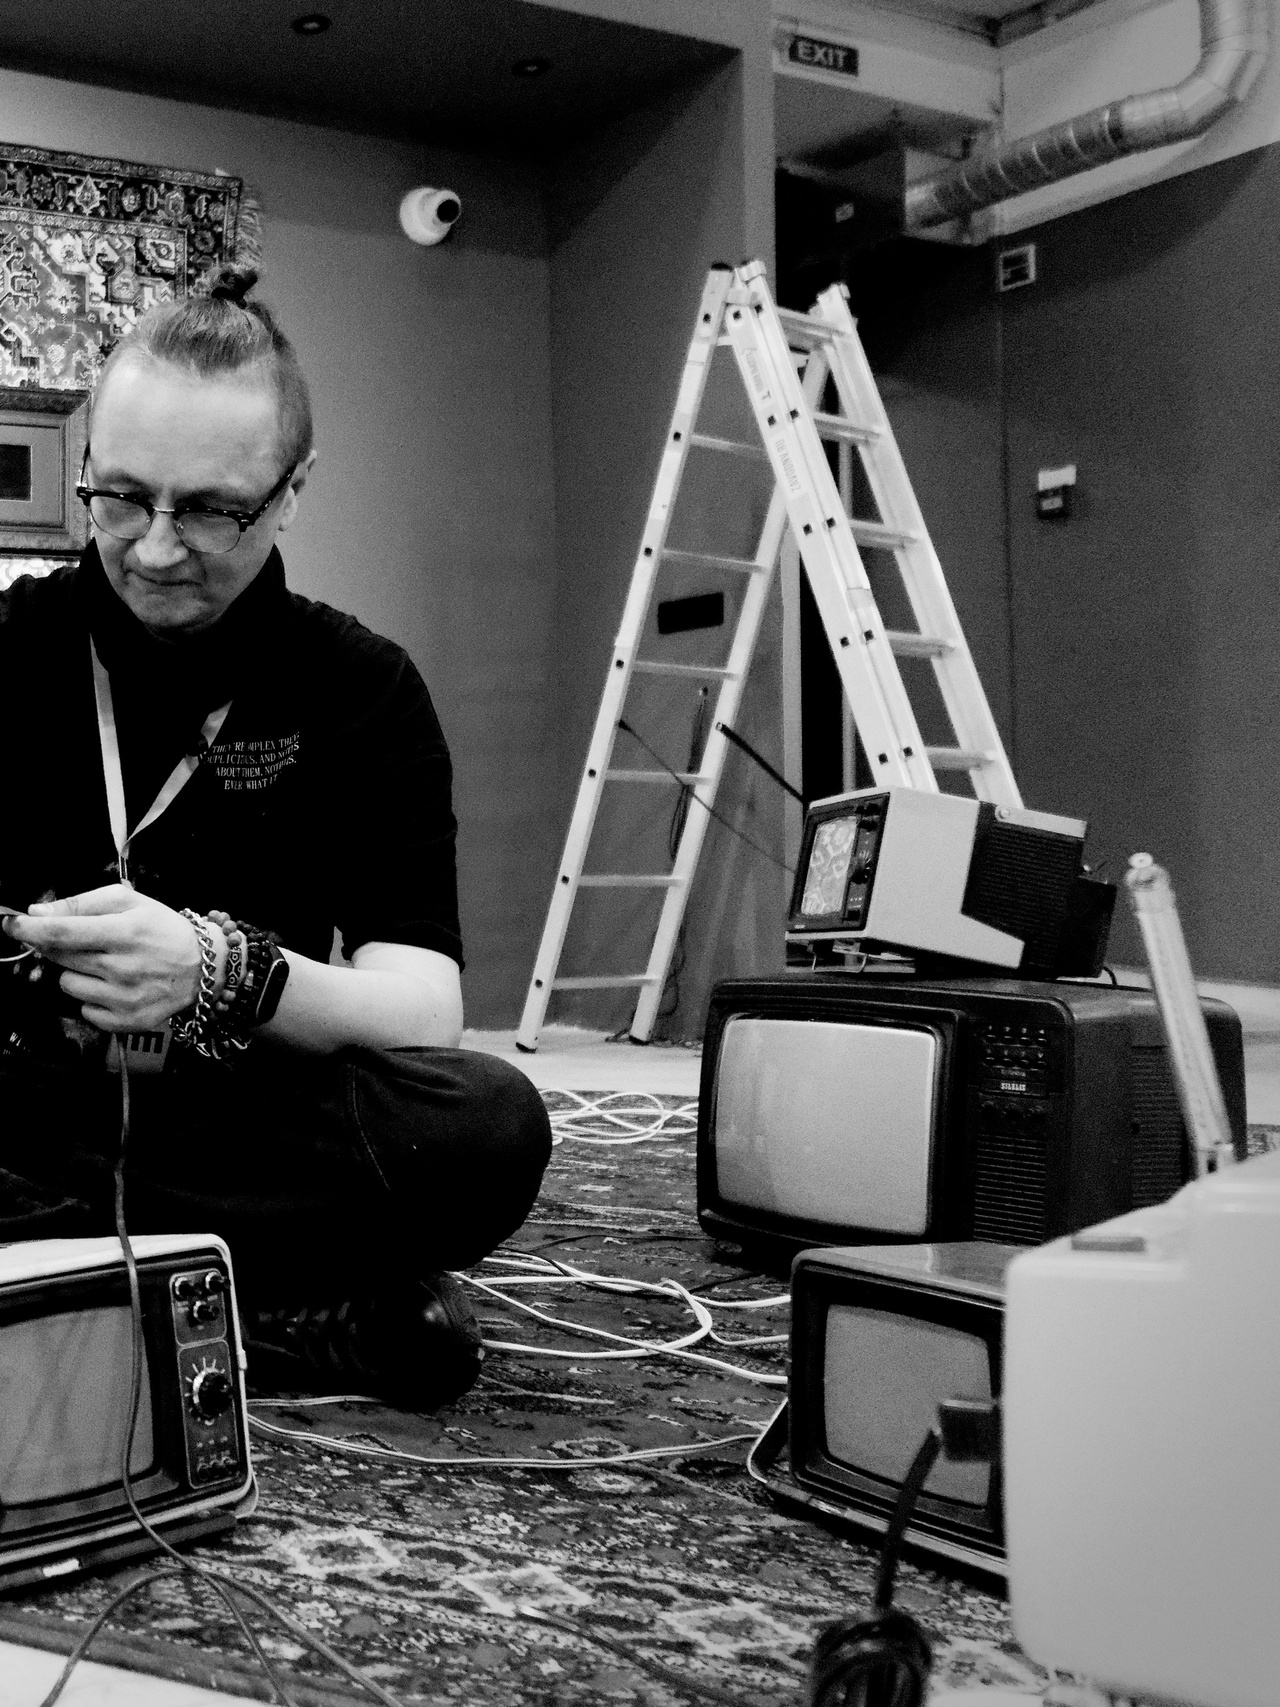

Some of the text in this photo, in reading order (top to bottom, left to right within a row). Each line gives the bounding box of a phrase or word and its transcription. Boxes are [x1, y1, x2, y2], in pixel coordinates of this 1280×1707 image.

[798, 41, 847, 68] EXIT
[259, 753, 276, 764] AND
[215, 767, 241, 778] ABOUT
[246, 778, 268, 790] WHAT
